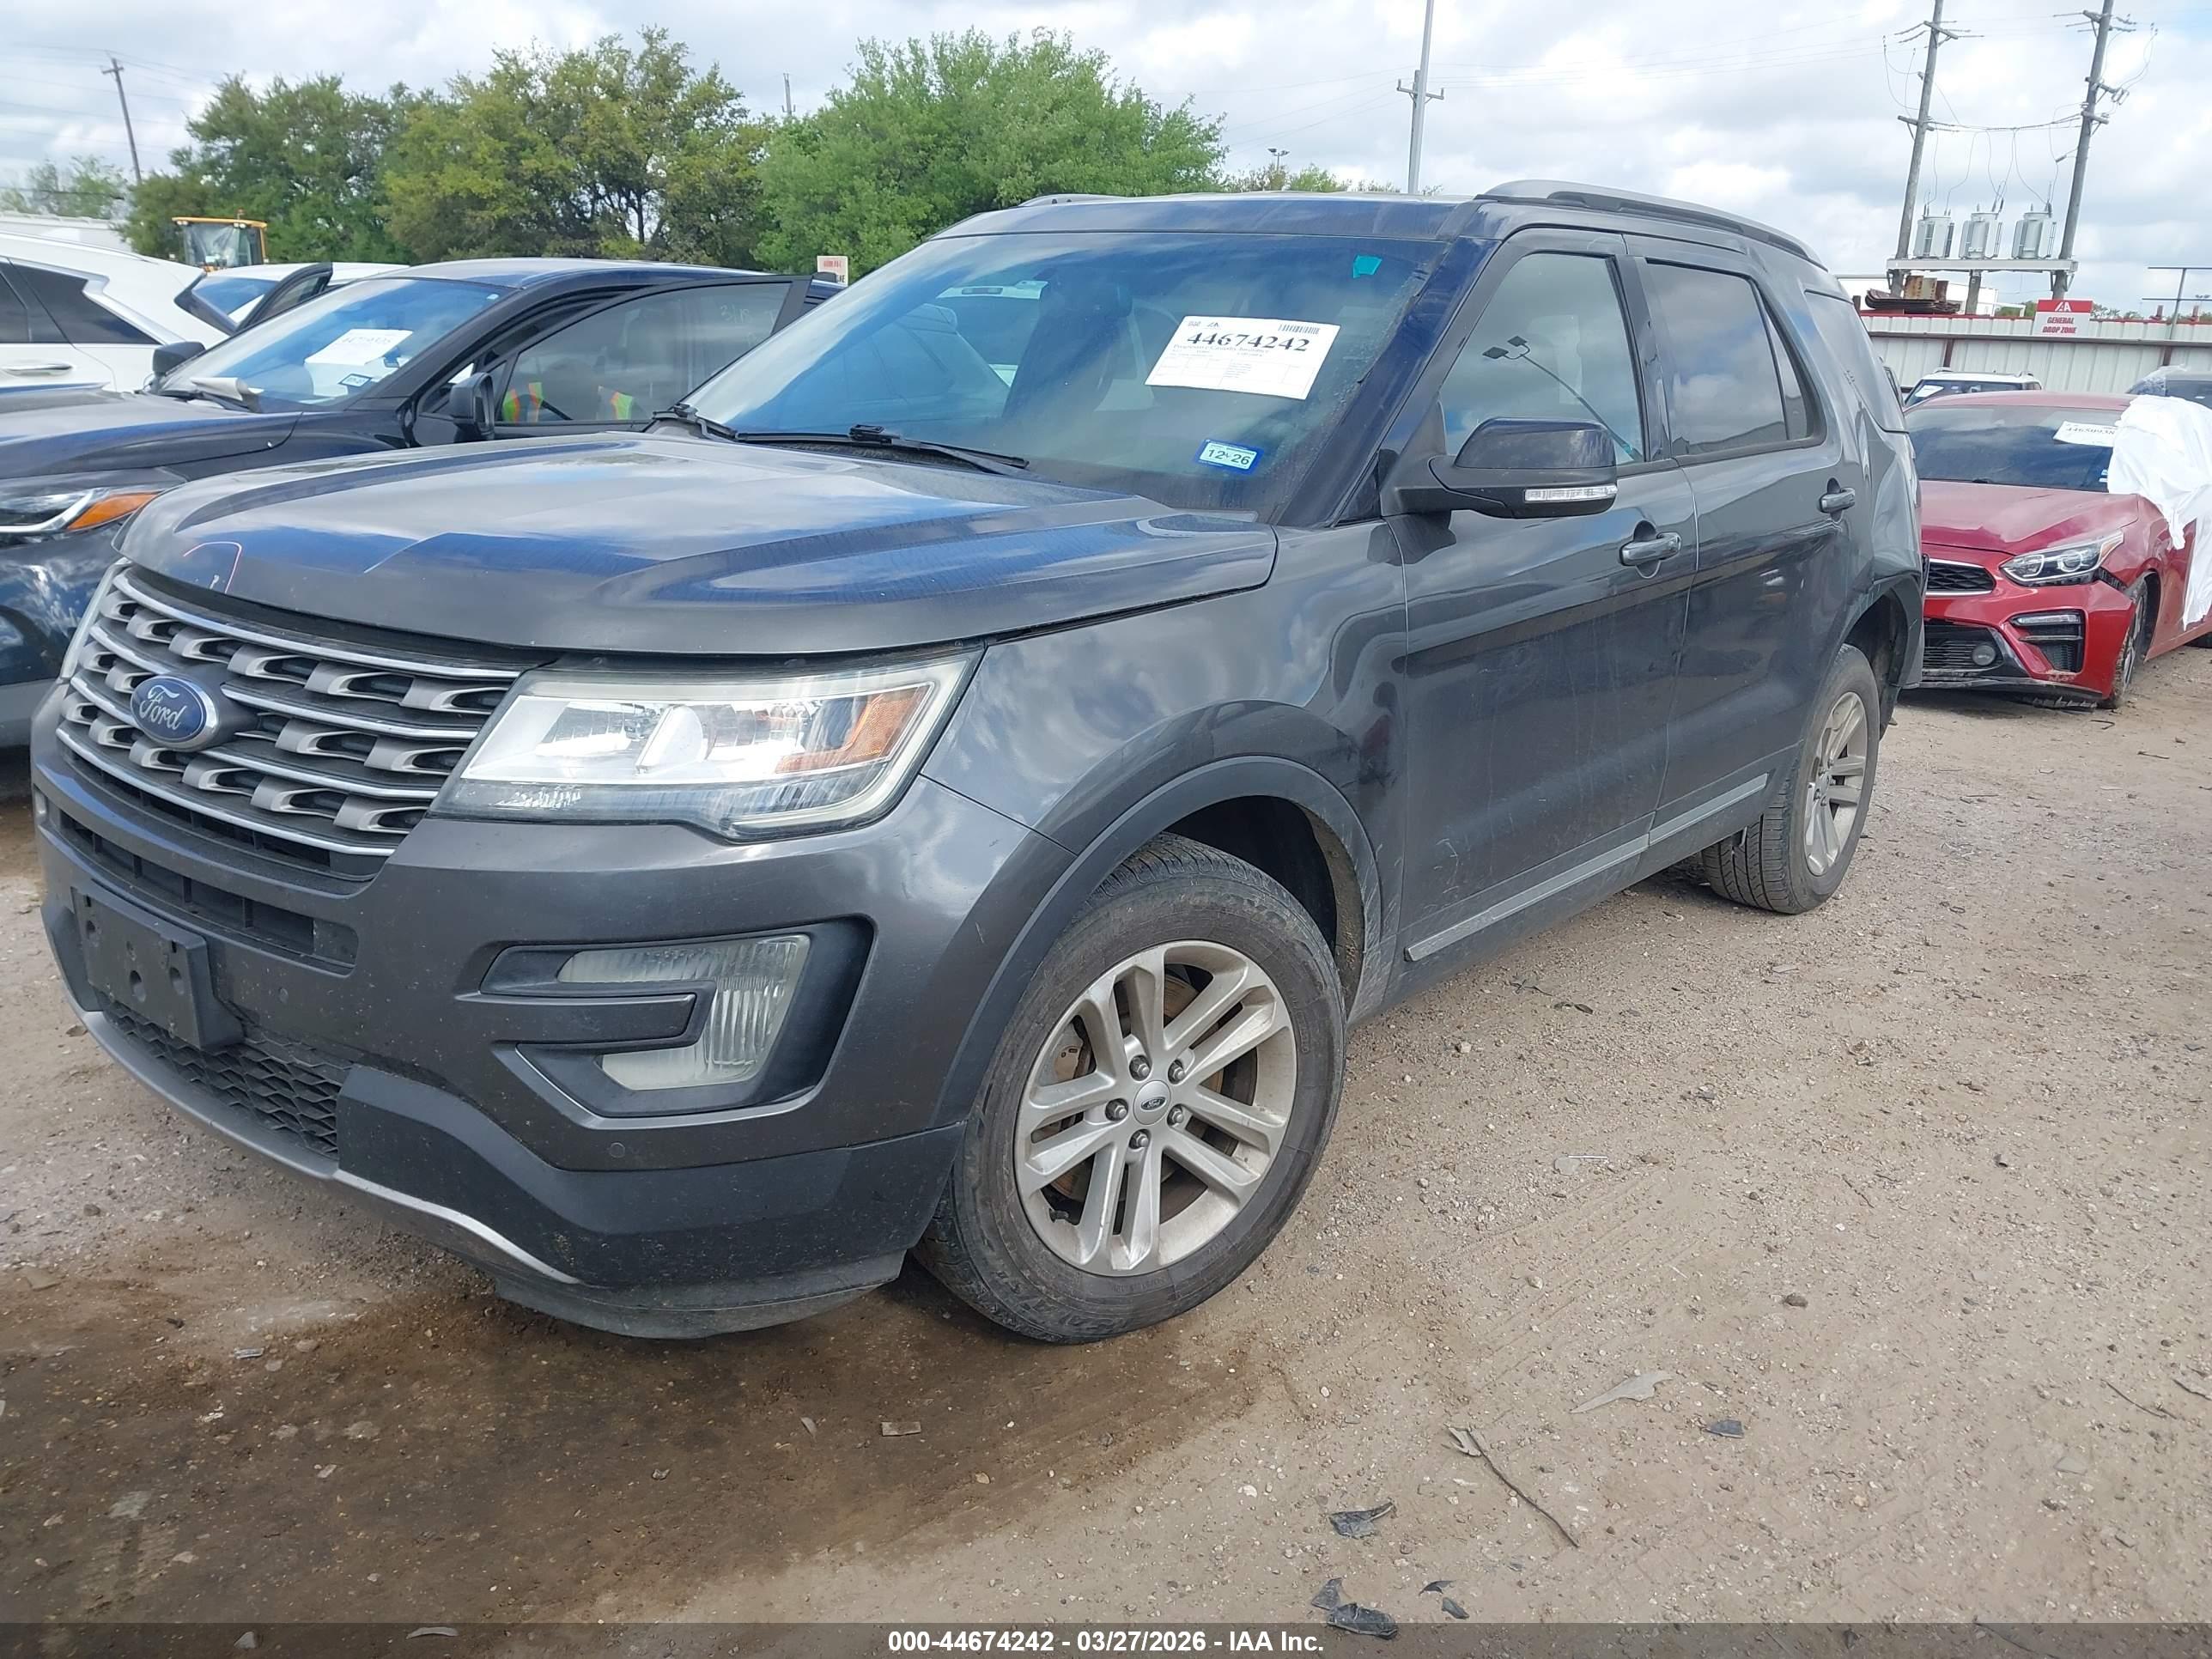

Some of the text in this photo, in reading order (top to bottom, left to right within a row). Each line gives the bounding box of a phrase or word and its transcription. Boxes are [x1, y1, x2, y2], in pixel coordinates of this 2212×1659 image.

[2046, 316, 2075, 325] GENERAL
[2042, 325, 2061, 334] DROP
[1187, 331, 1310, 352] 44674242
[1208, 449, 1225, 459] 12
[1231, 453, 1251, 465] 26
[139, 684, 188, 731] Ford
